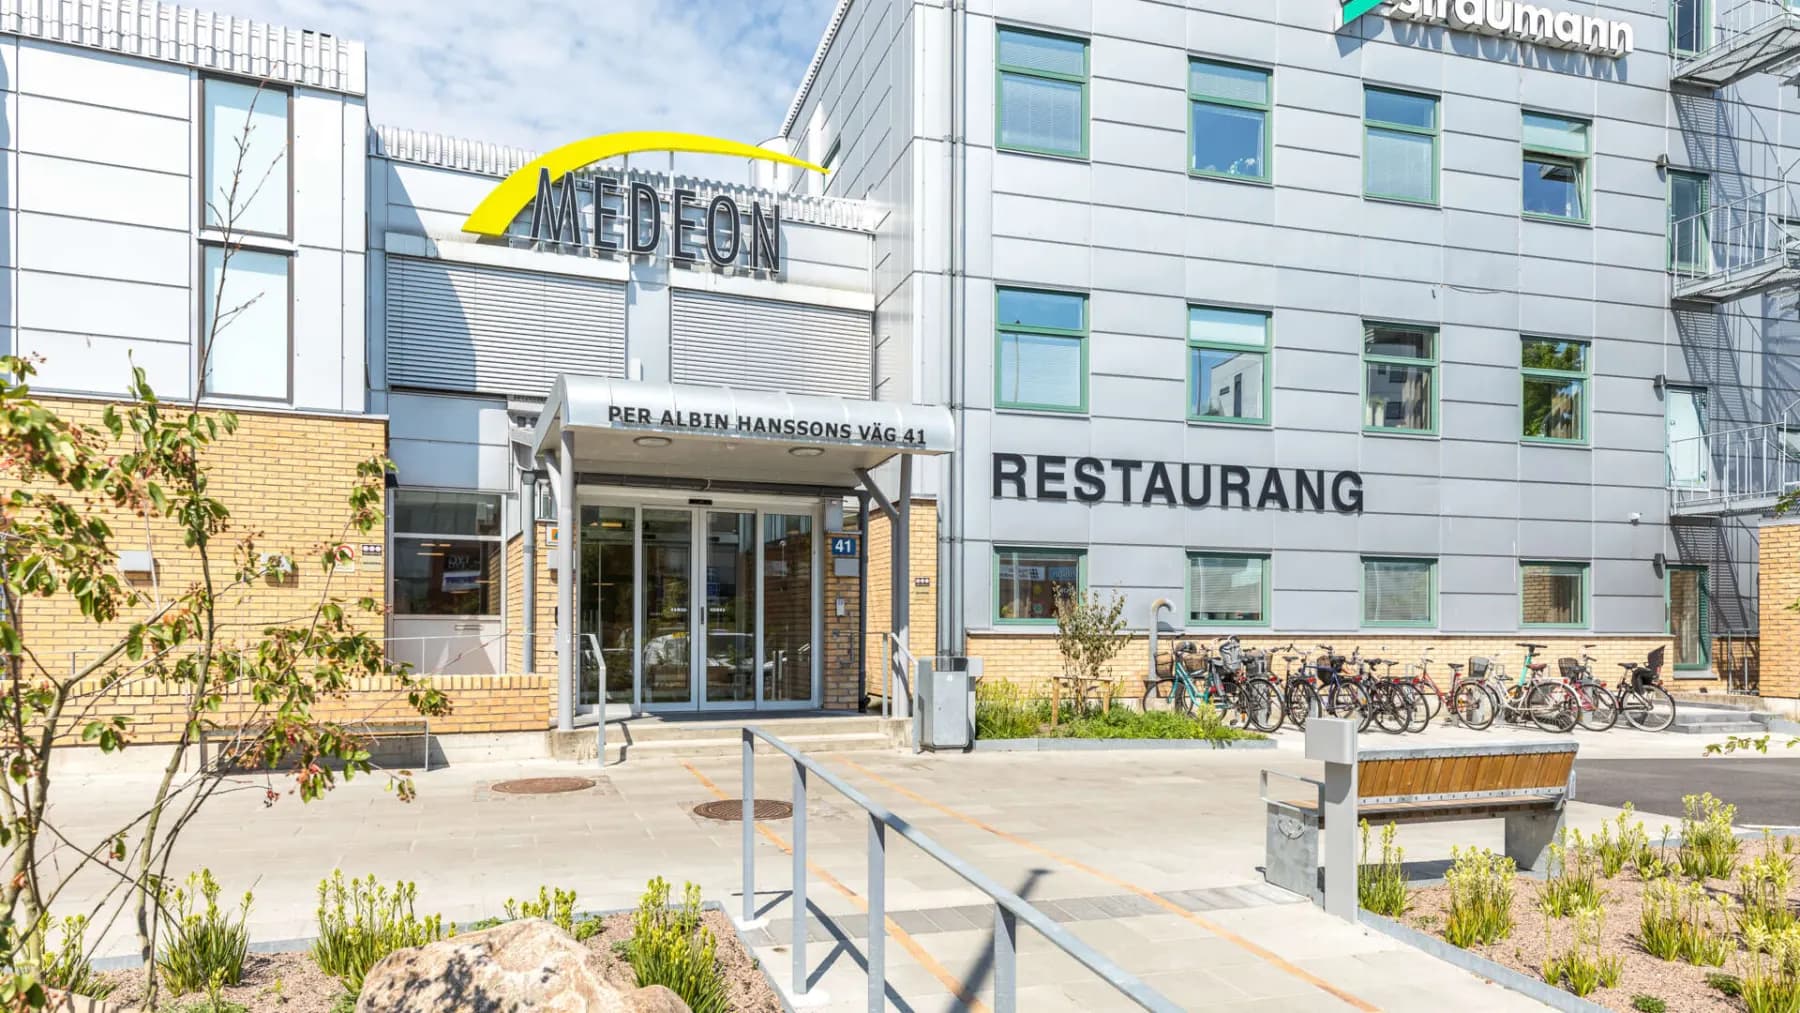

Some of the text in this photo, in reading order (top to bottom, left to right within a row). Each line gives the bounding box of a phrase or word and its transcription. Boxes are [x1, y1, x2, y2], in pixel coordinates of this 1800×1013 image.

[529, 167, 780, 273] MEDEON
[608, 405, 927, 445] PER ALBIN HANSSONS VÄG 41
[992, 452, 1364, 515] RESTAURANG
[834, 538, 851, 553] 41
